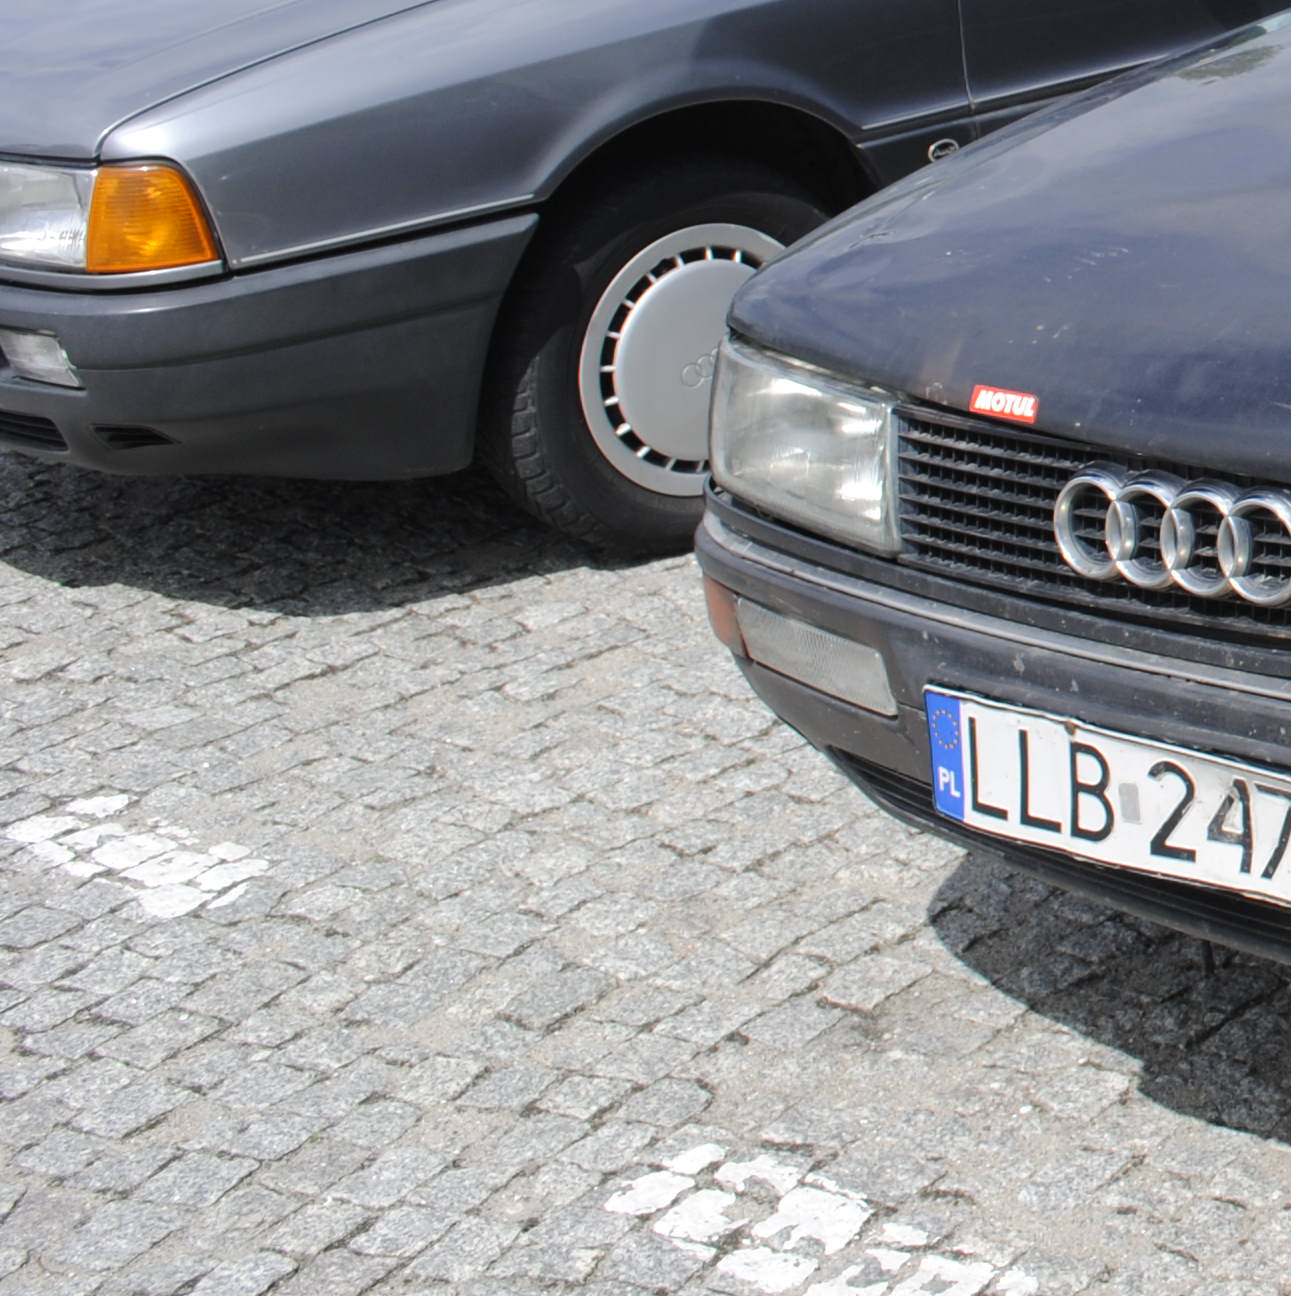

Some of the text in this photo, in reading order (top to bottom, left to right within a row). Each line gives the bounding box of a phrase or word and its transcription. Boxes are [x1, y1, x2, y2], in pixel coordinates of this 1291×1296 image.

[974, 389, 1035, 417] MOTUL
[937, 766, 961, 798] PL
[968, 716, 1115, 842] LLB
